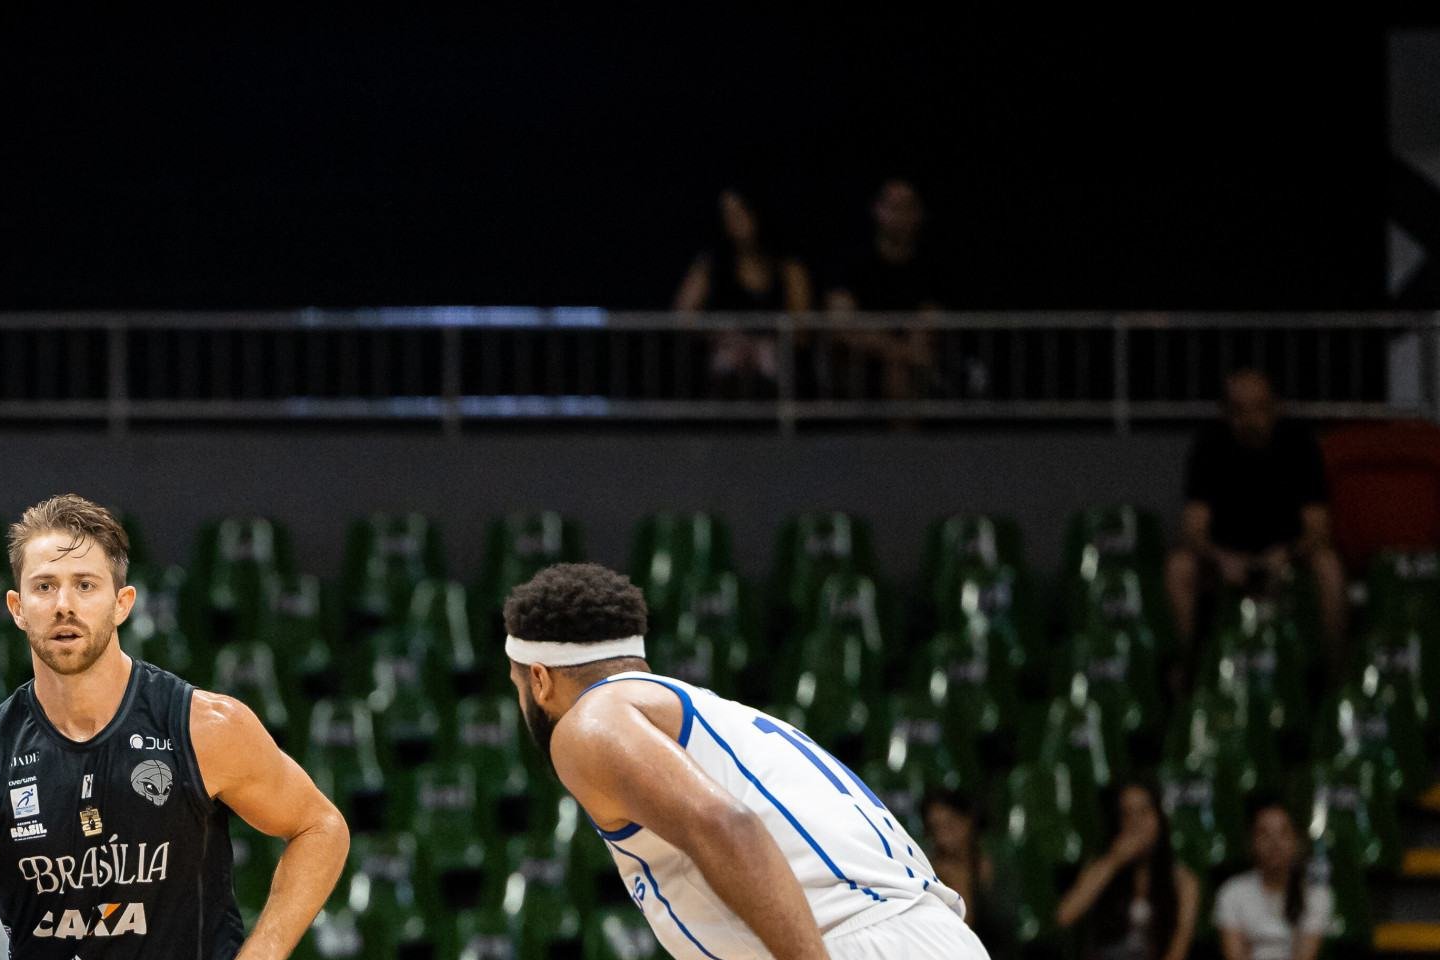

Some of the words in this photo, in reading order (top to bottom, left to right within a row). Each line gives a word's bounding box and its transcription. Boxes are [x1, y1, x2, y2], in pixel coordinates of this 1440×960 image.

[10, 751, 40, 768] JADE
[10, 823, 48, 838] BRASIL
[18, 833, 170, 895] BRASÍLIA
